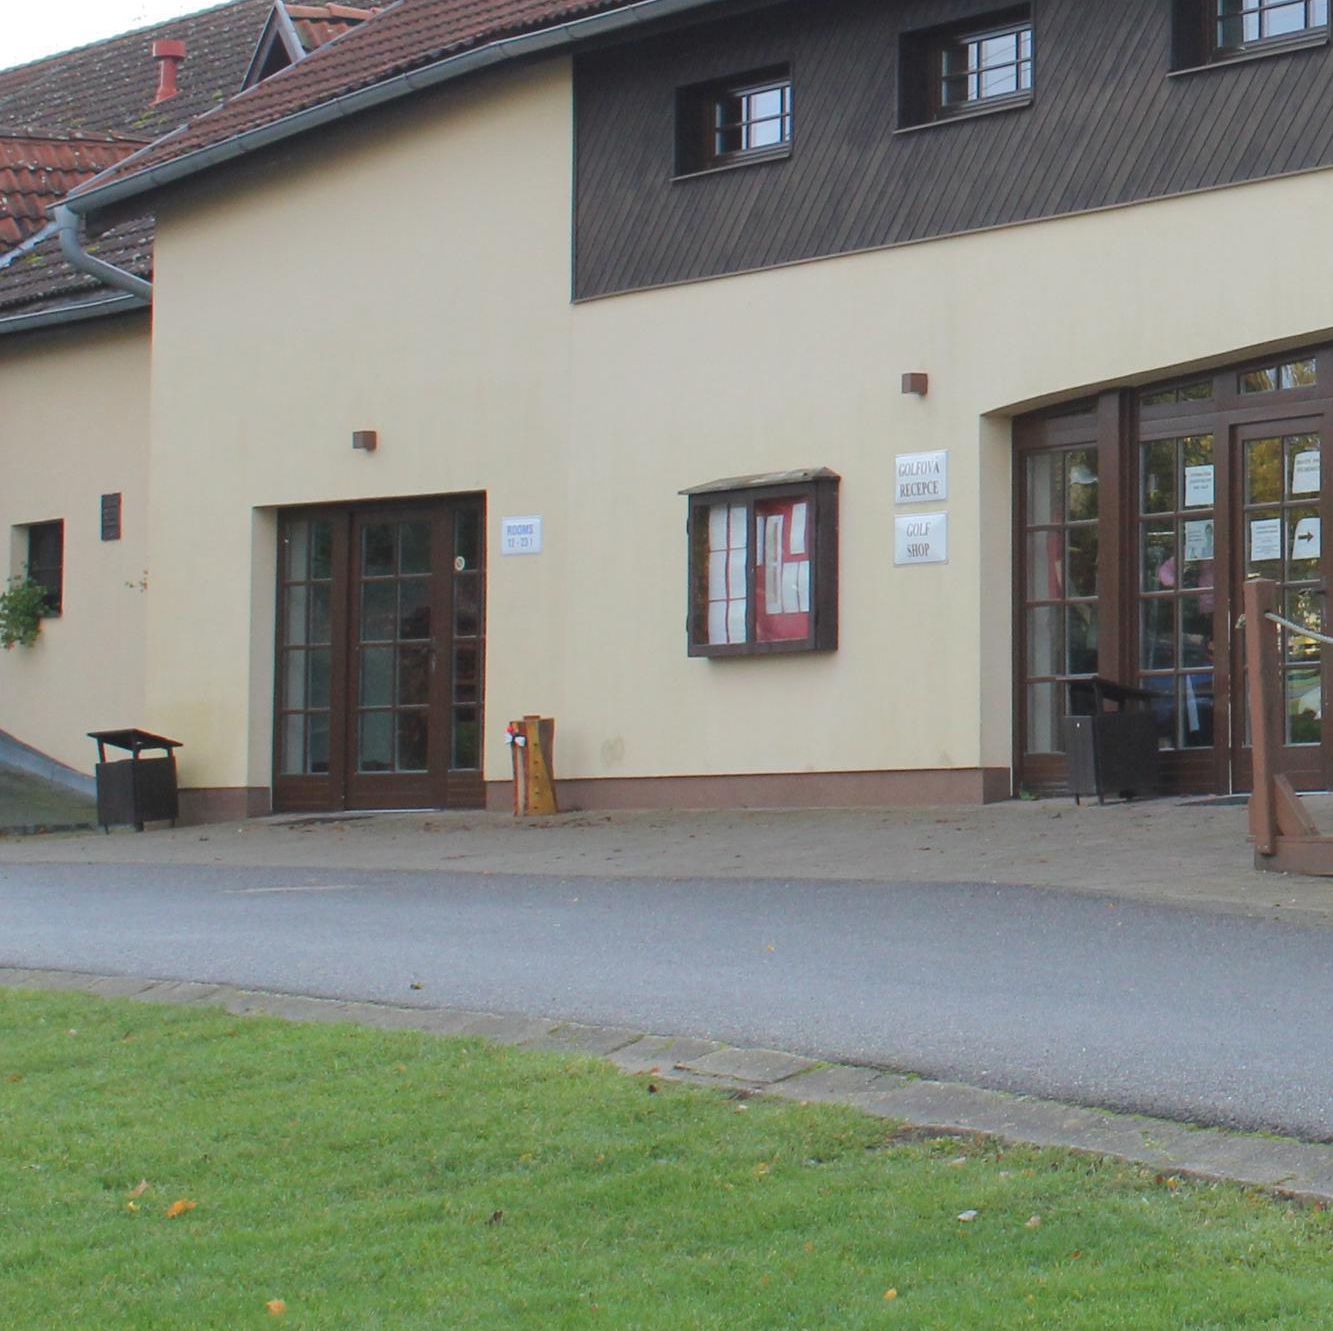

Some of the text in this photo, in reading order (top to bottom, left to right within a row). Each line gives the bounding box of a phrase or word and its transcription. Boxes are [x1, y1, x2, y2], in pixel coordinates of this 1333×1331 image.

[900, 481, 939, 498] RECEPCE
[507, 524, 533, 536] ROOMS
[906, 522, 930, 537] GOLF
[907, 543, 930, 558] SHOP
